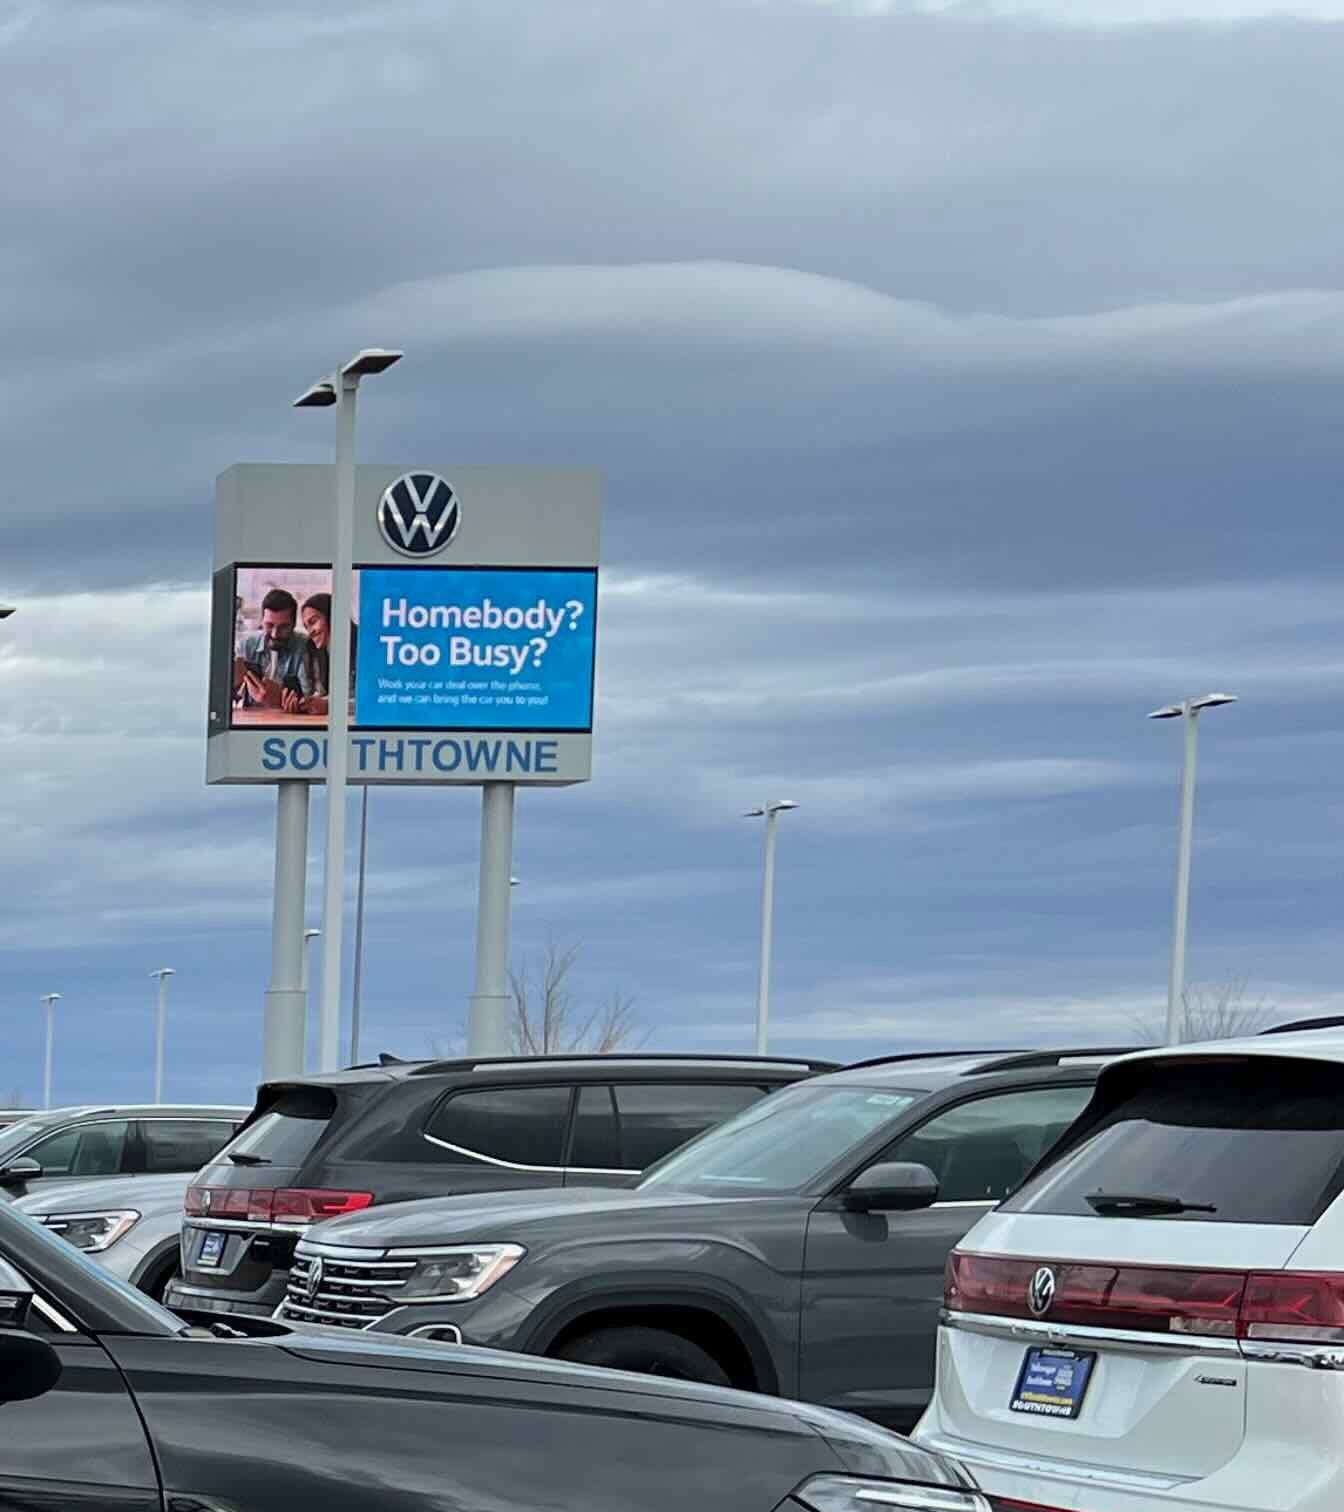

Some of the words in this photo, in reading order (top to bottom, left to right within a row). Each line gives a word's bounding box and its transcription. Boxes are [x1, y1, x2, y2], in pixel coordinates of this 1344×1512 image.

[382, 598, 584, 638] Homebody?
[379, 635, 441, 666] Too
[449, 636, 548, 675] Busy?
[377, 693, 397, 703] and
[433, 694, 459, 707] bring
[461, 694, 477, 704] the
[515, 696, 525, 704] to
[262, 737, 558, 773] SOTHTOWNE
